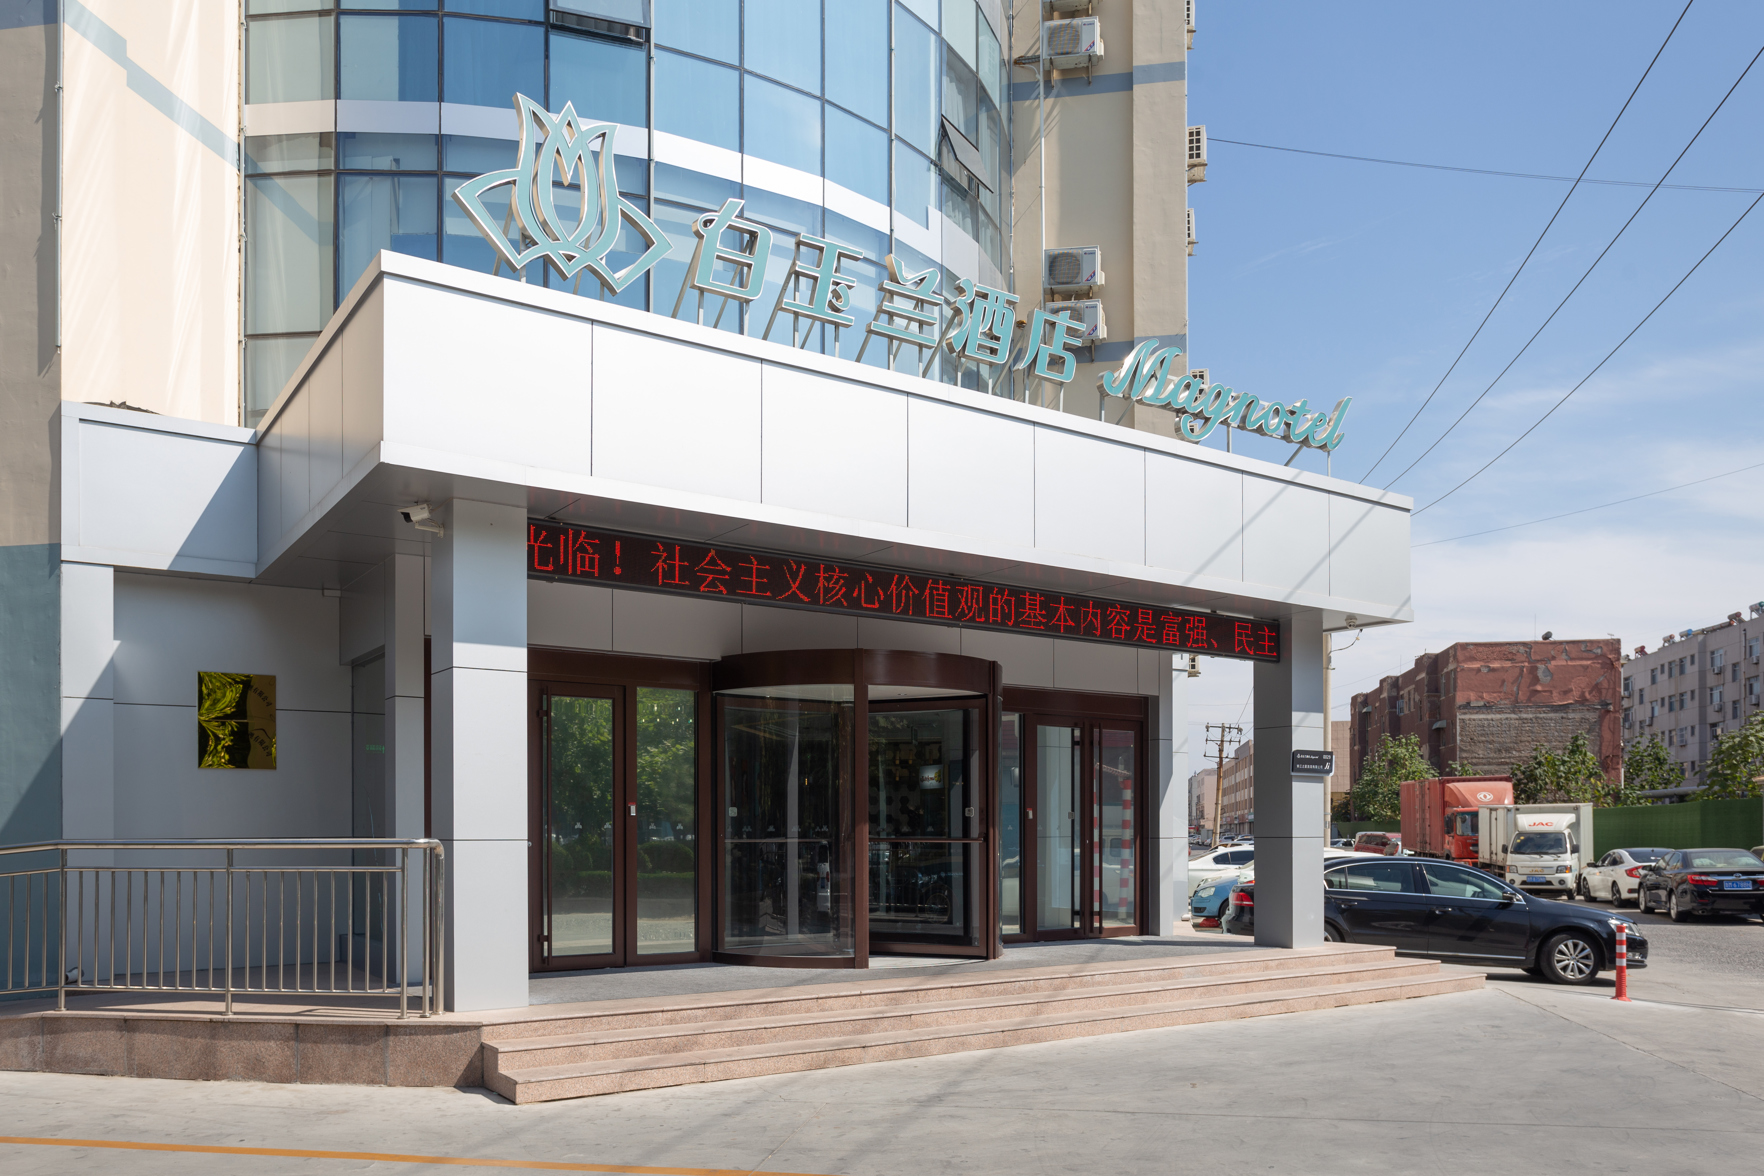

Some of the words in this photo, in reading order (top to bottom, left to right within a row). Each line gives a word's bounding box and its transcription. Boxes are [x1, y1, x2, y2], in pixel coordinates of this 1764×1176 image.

[690, 198, 1087, 384] 白玉兰酒店
[1096, 338, 1353, 452] Magnotel
